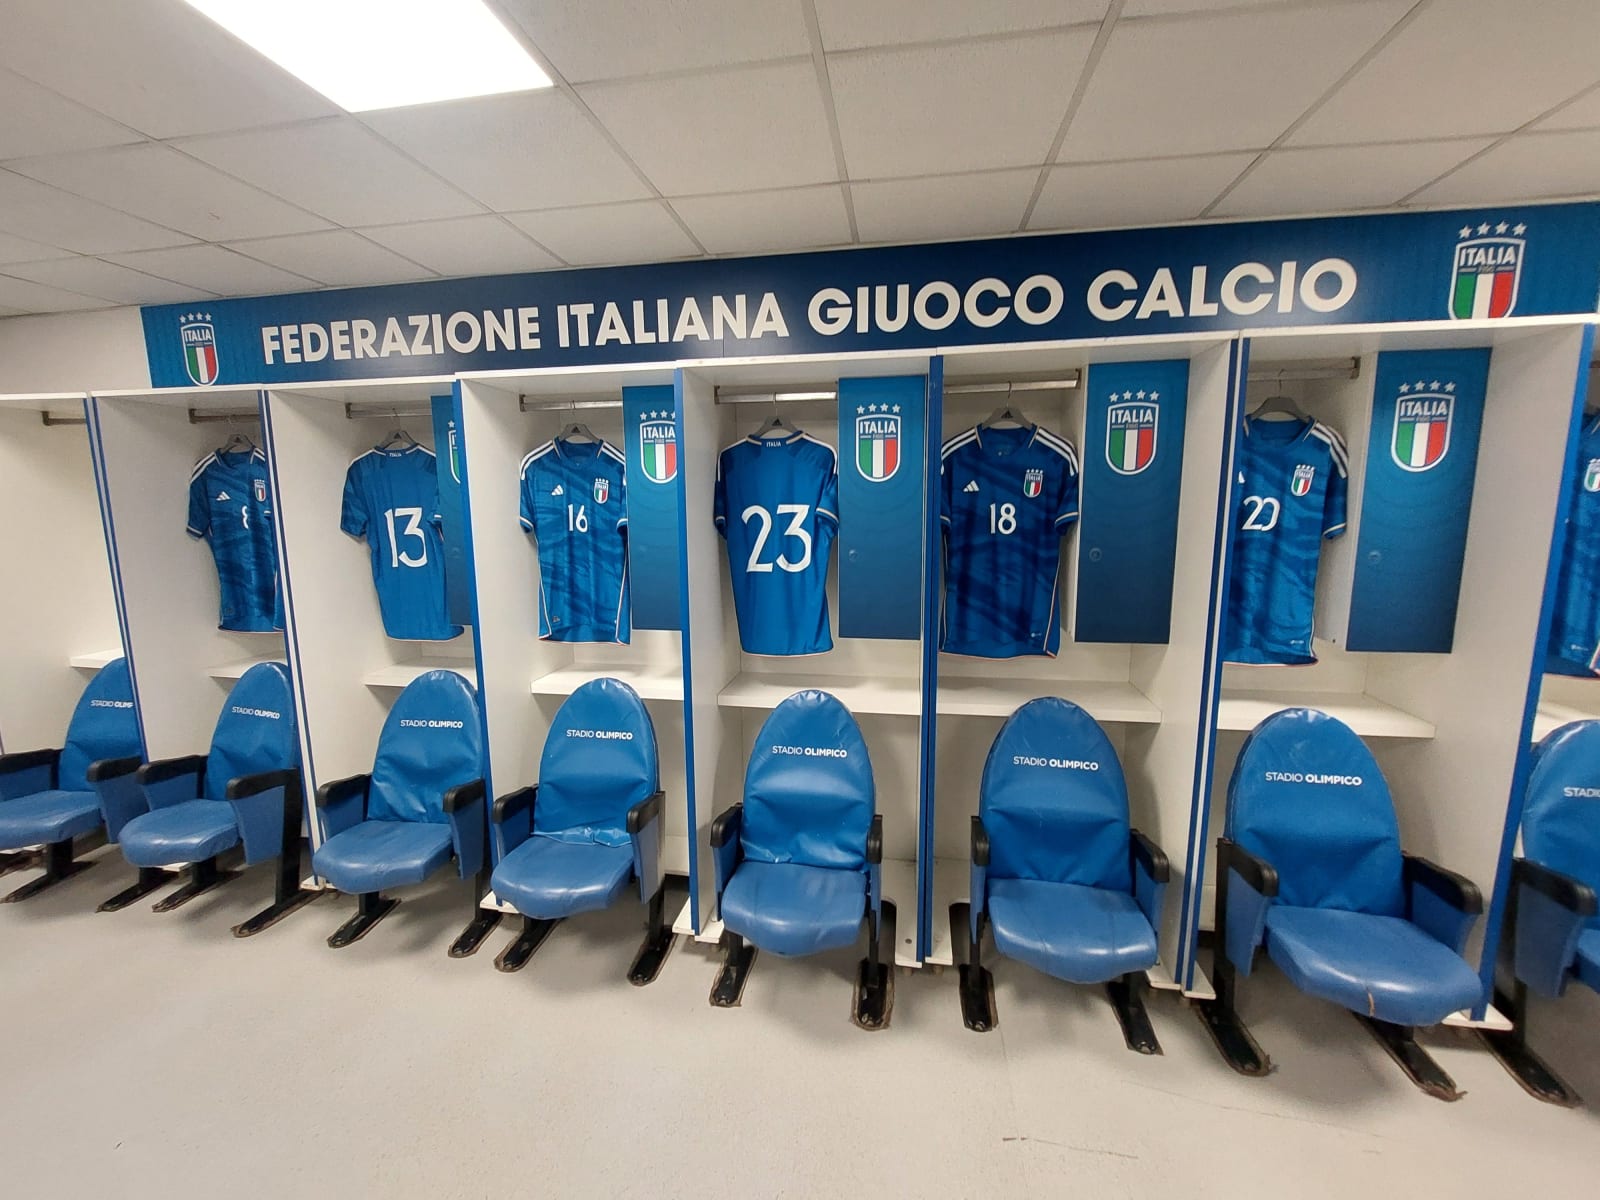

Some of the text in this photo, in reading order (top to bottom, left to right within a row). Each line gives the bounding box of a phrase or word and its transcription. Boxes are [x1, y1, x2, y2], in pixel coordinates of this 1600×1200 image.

[1459, 246, 1516, 267] ITALIA
[261, 258, 1358, 364] FEDERAZIONE ITALIANA GIUOCO CALCIO
[184, 328, 213, 342] ITALIA
[1400, 400, 1448, 416] ITALIA
[1111, 408, 1154, 424] ITALIA
[643, 426, 676, 439] ITALIA
[860, 420, 897, 434] ITALIA
[567, 503, 588, 533] 16
[989, 502, 1018, 535] 18
[384, 507, 428, 568] 13
[741, 504, 812, 573] 23
[231, 706, 281, 720] STADIO OLIMPICO
[400, 719, 464, 729] STADIO OLIMPICO
[566, 729, 633, 741] STADIO OLIMPICO
[772, 745, 848, 758] STADIO OLIMPICO
[1013, 755, 1099, 771] STADIO OLIMPICO
[1265, 771, 1363, 786] STADIO OLIMPICO
[1563, 786, 1600, 798] STADI
